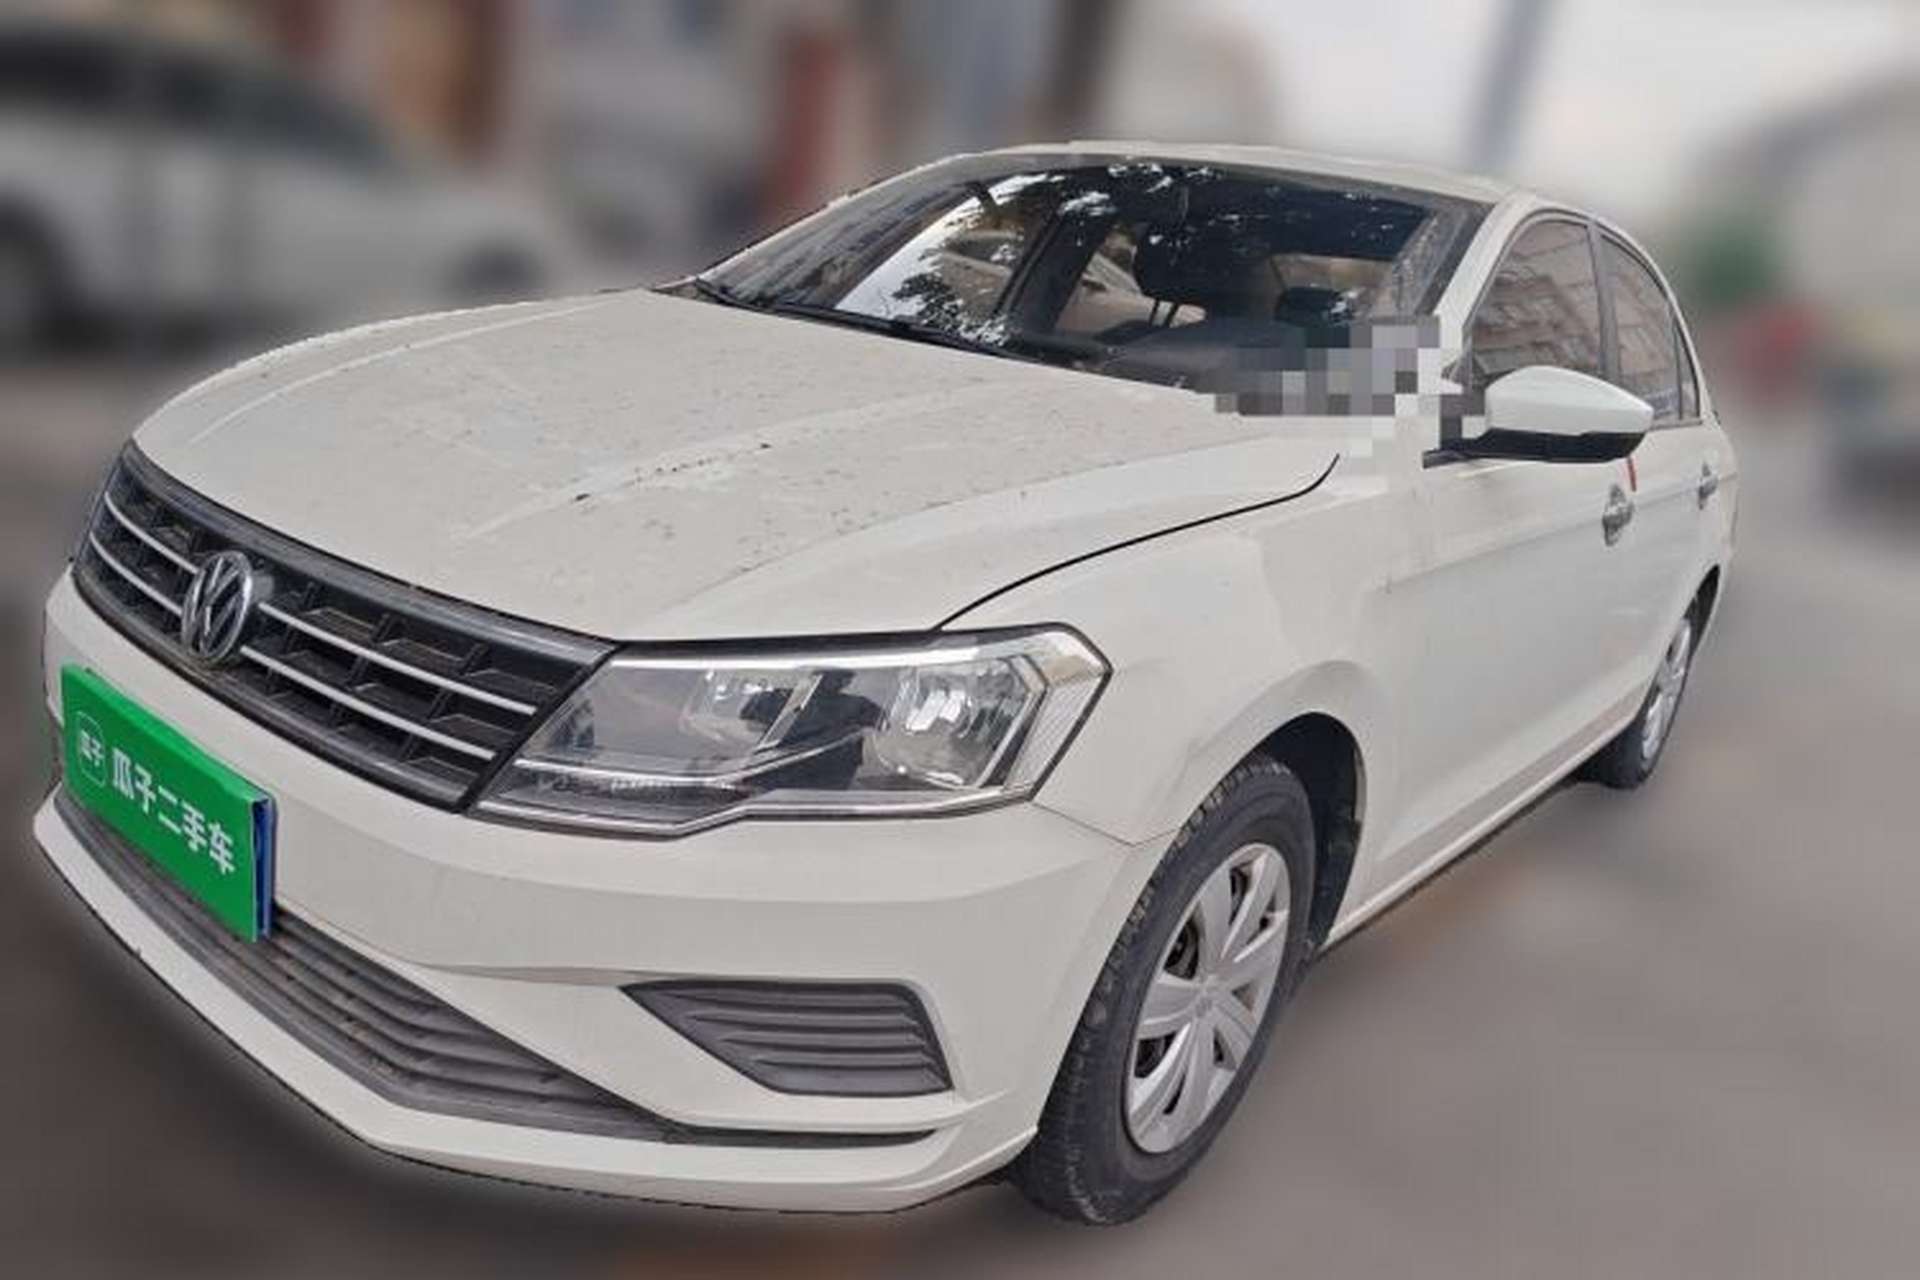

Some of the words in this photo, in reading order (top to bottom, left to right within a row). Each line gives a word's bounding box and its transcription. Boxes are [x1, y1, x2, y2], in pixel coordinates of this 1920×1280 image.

[112, 747, 235, 875] 瓜子二手车
